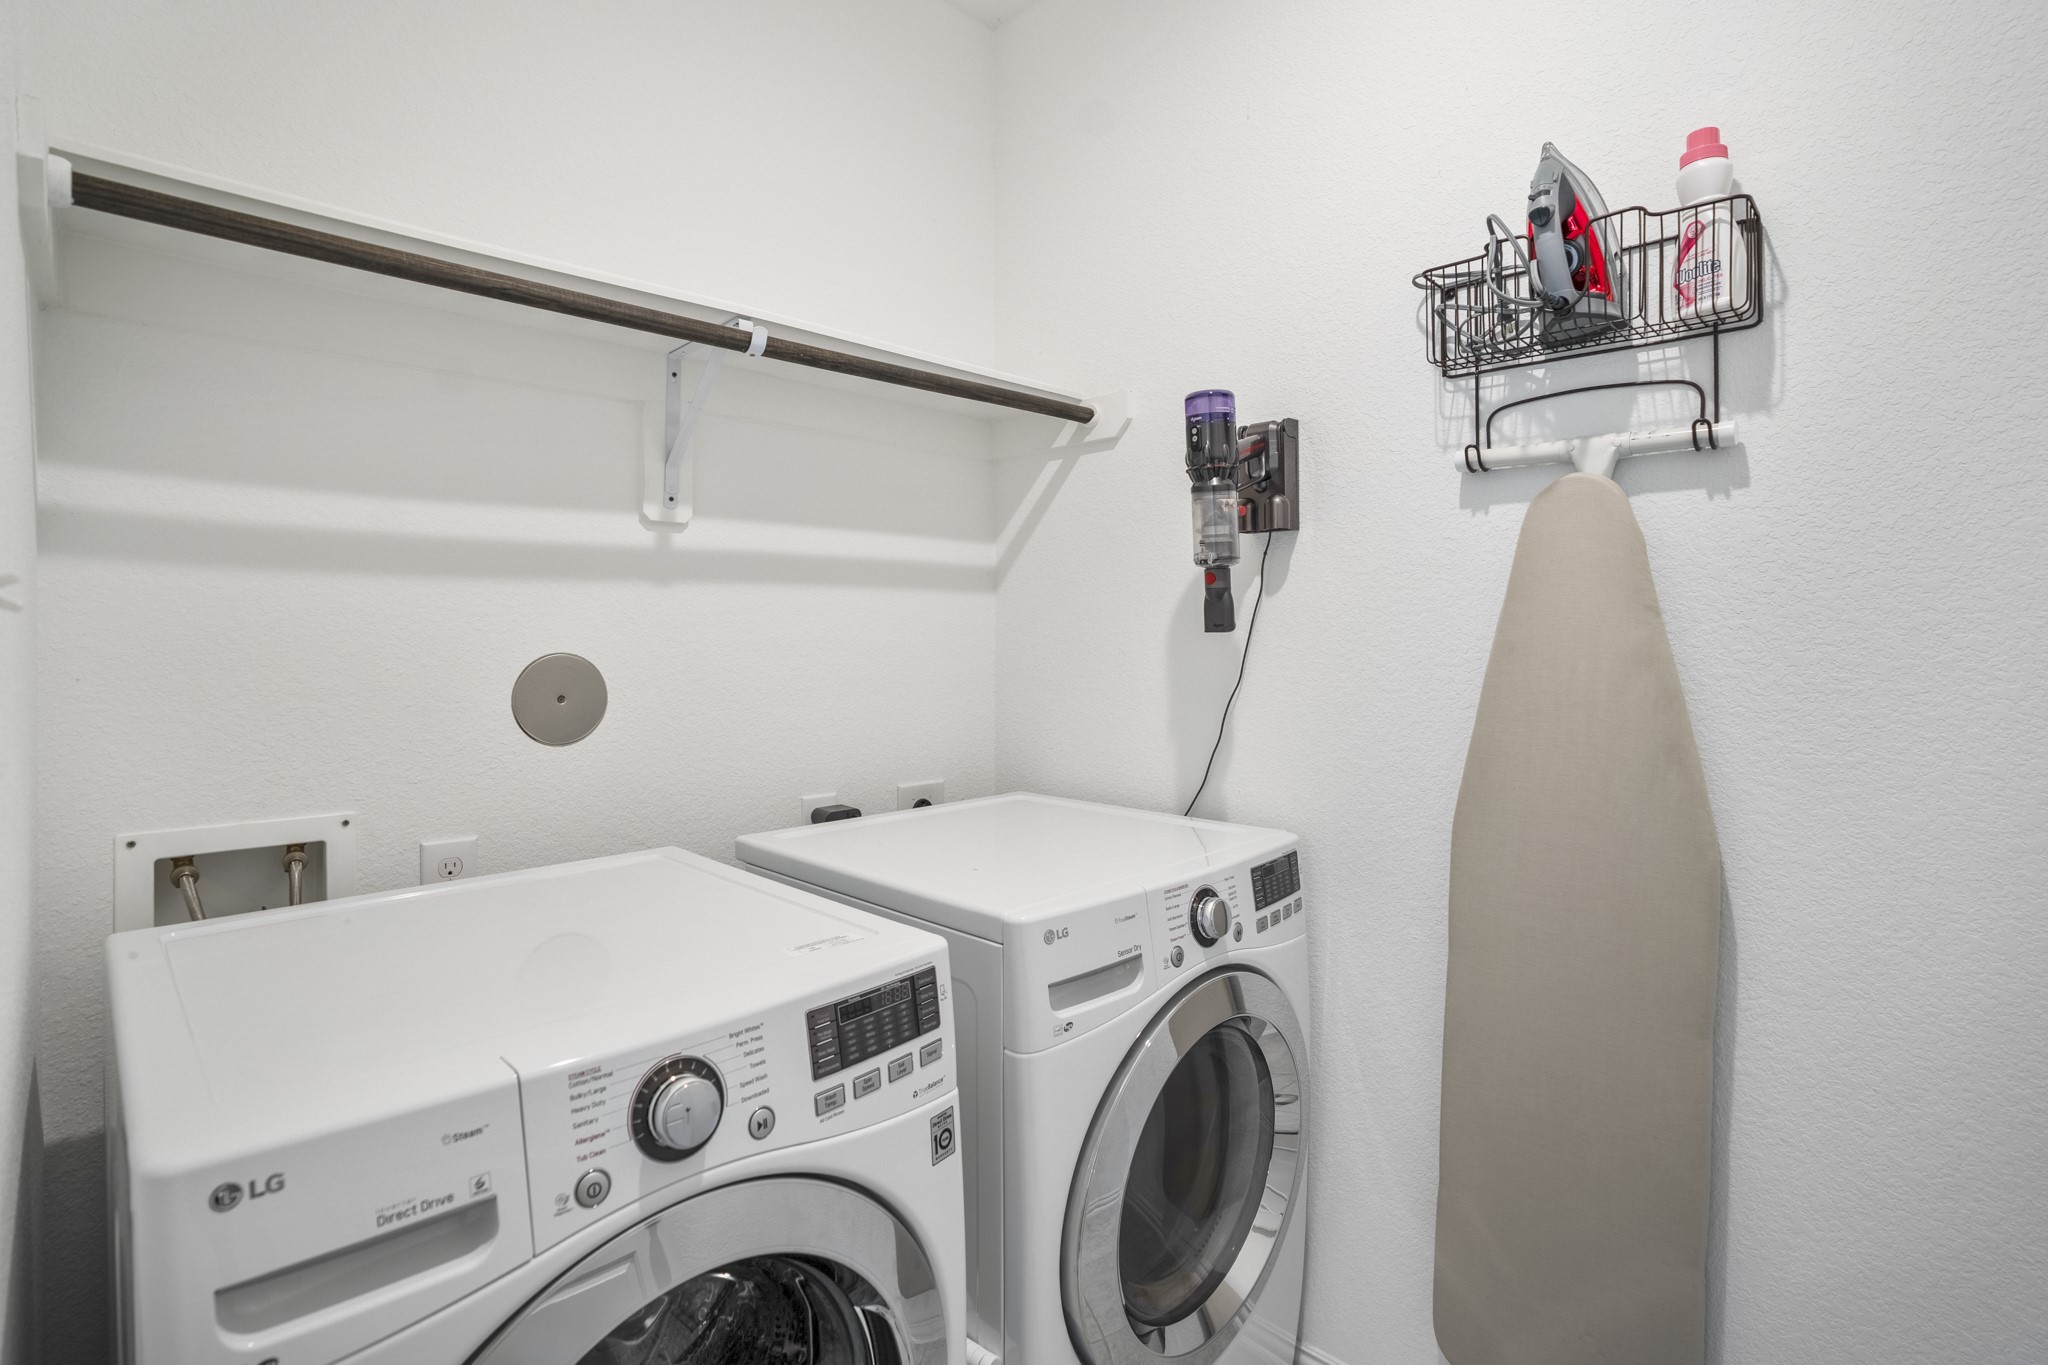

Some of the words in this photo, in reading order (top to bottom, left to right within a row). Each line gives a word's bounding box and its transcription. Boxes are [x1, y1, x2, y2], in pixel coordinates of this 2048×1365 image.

[1675, 259, 1721, 285] Woolite
[1056, 927, 1069, 940] LG
[1117, 946, 1133, 958] Sensor
[1133, 943, 1142, 953] Dry
[728, 1030, 744, 1039] Bright
[743, 1046, 765, 1058] Delicates
[749, 1059, 766, 1069] Towels
[739, 1078, 755, 1089] Speed
[755, 1073, 768, 1083] Wash
[862, 1082, 875, 1092] Speed
[741, 1087, 770, 1104] Downloaded
[823, 1092, 837, 1102] Wash
[592, 1099, 606, 1109] Duty
[825, 1099, 837, 1109] Temp
[572, 1117, 599, 1130] Sanitary
[933, 1128, 953, 1155] 10
[248, 1172, 286, 1201] LG
[376, 1204, 418, 1228] Direct
[420, 1192, 455, 1213] Drive
